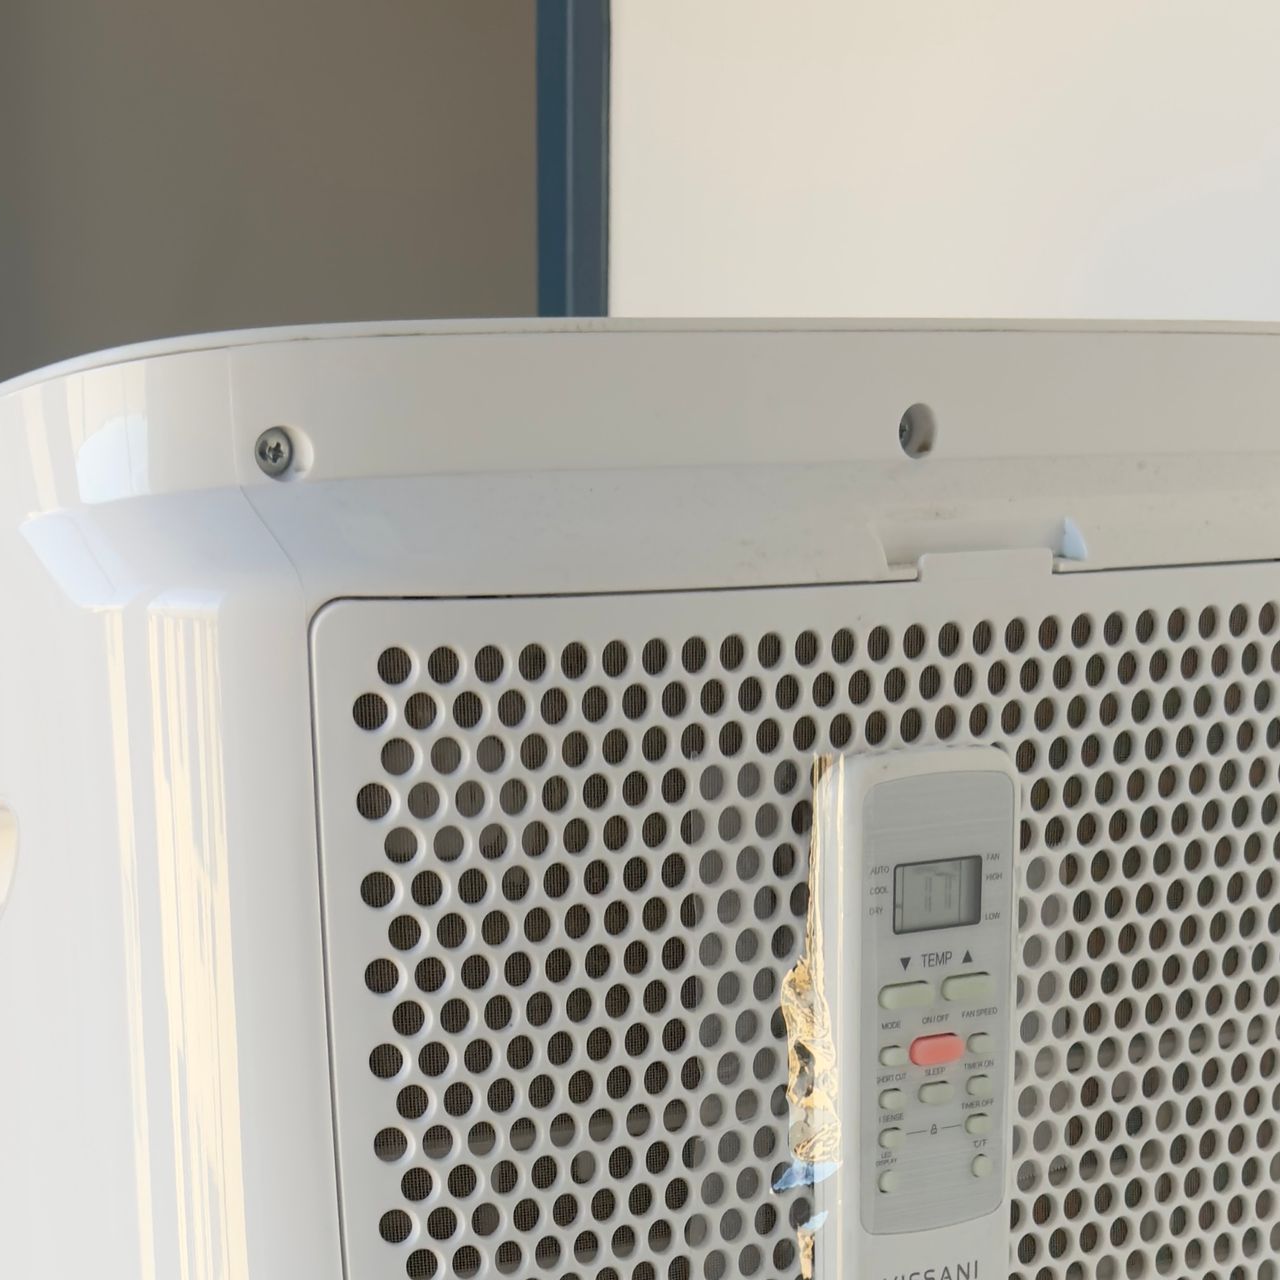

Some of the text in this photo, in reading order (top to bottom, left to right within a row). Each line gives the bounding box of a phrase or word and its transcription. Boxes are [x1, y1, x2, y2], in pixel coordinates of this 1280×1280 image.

[986, 853, 1000, 862] FAN
[870, 865, 890, 874] AUTO
[985, 872, 1003, 882] HIGH
[869, 885, 888, 896] COOL
[868, 906, 883, 916] DRY
[985, 912, 1001, 921] LOW
[921, 950, 953, 968] TEMP
[961, 1006, 998, 1019] FAN SPEED
[881, 1020, 902, 1030] MODE
[964, 1060, 994, 1071] TIMER ON
[895, 1072, 907, 1081] CUT
[925, 1066, 946, 1077] SLEEP
[961, 1098, 994, 1110] TIMER OFF
[882, 1113, 904, 1123] SENSE
[880, 1151, 892, 1159] LED
[875, 1158, 897, 1168] DISPLAY
